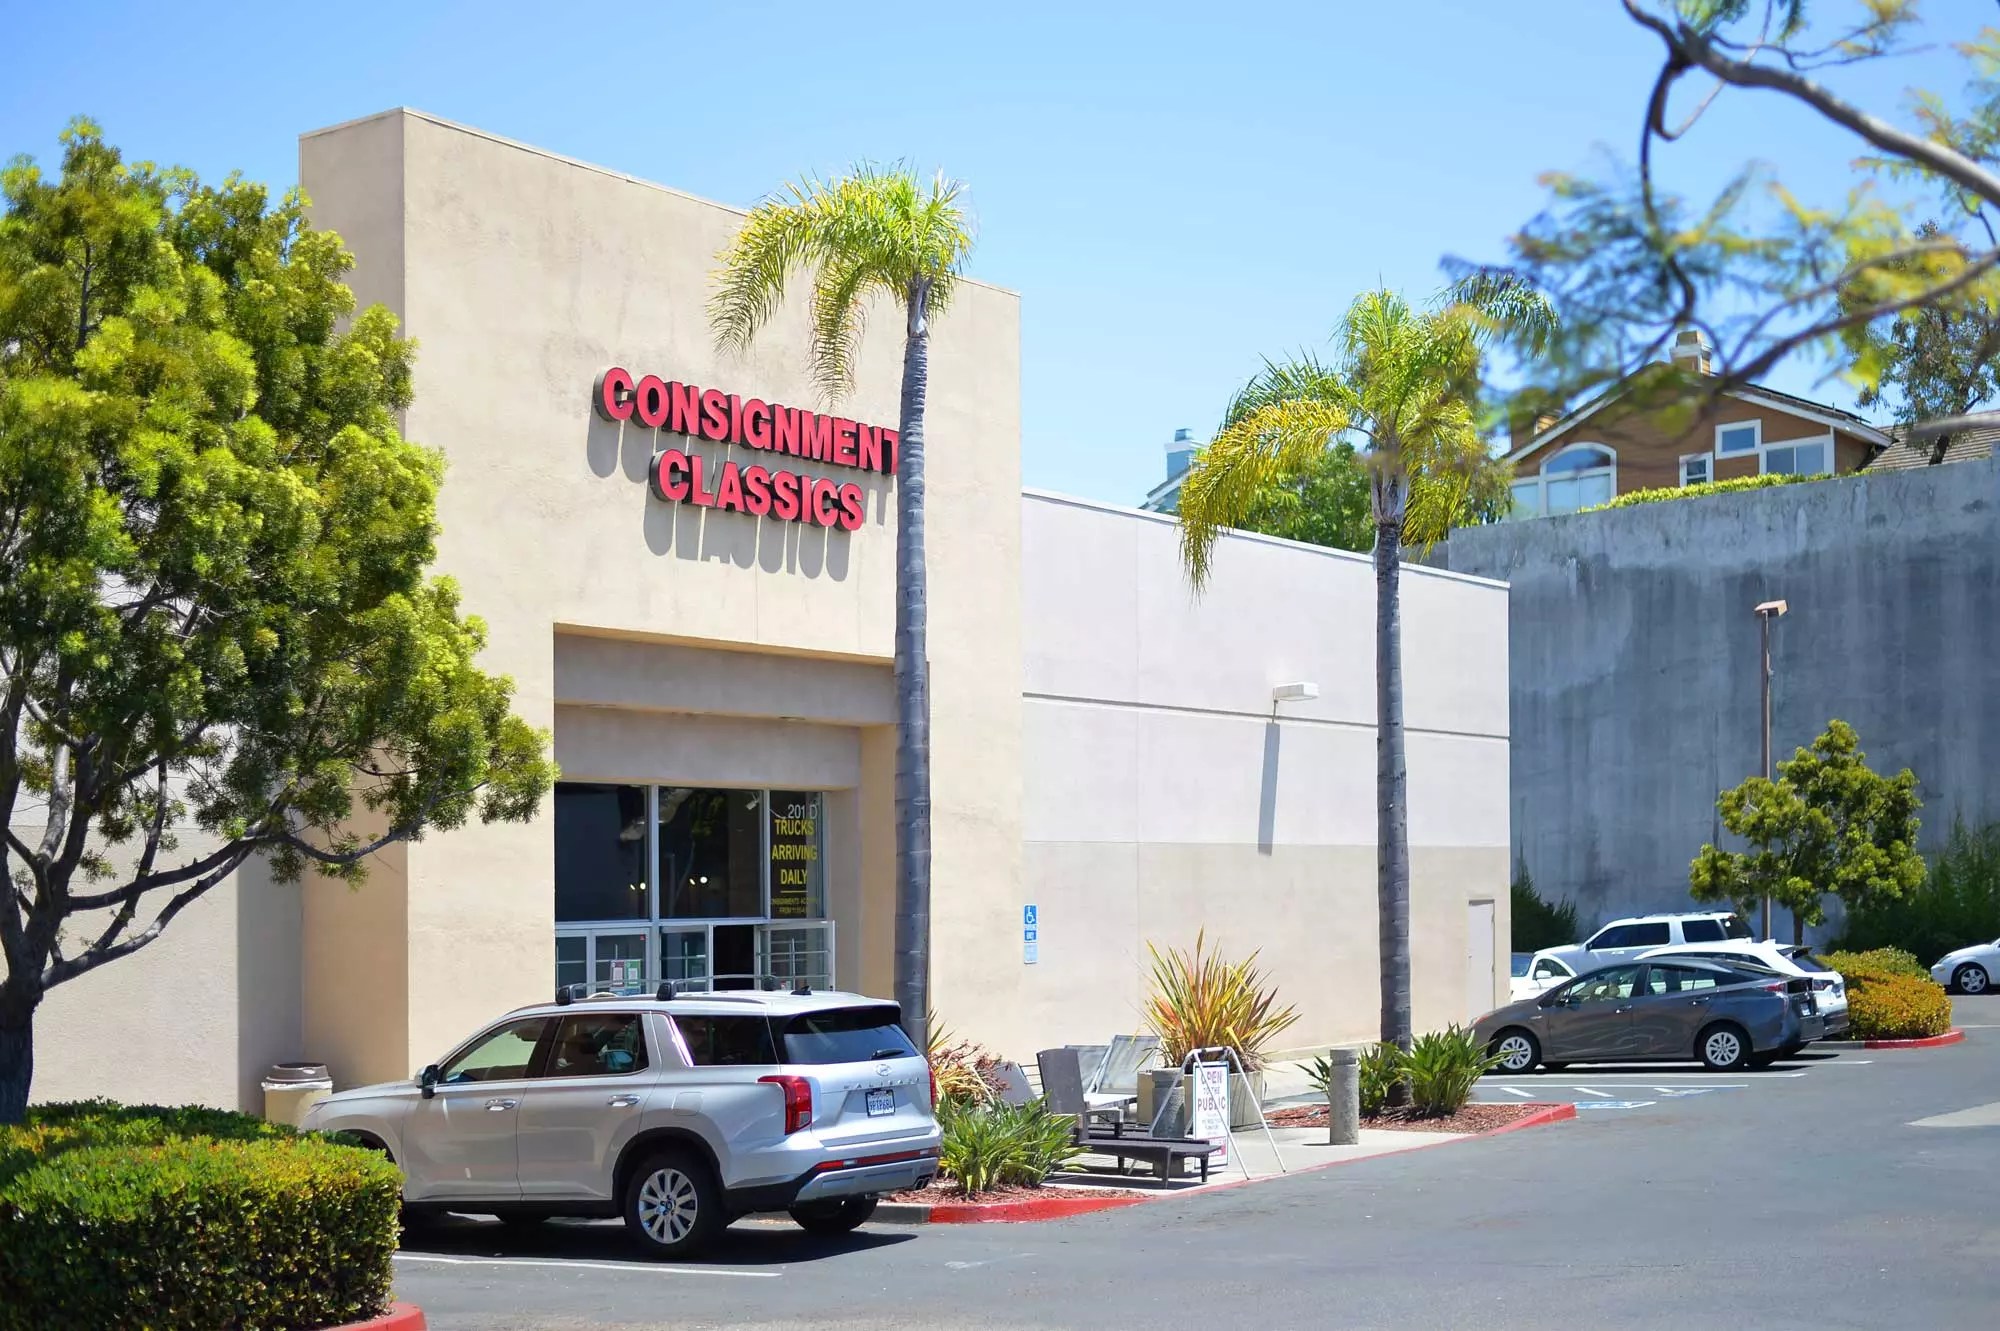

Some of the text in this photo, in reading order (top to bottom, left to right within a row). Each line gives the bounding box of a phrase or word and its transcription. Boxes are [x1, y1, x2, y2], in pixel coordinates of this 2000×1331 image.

[594, 366, 899, 476] CONSIGNMENT
[651, 449, 864, 531] CLASSICS
[788, 803, 806, 819] 201
[774, 819, 815, 836] TRUCKS
[771, 844, 818, 860] ARRIVING
[780, 868, 808, 885] DAILY
